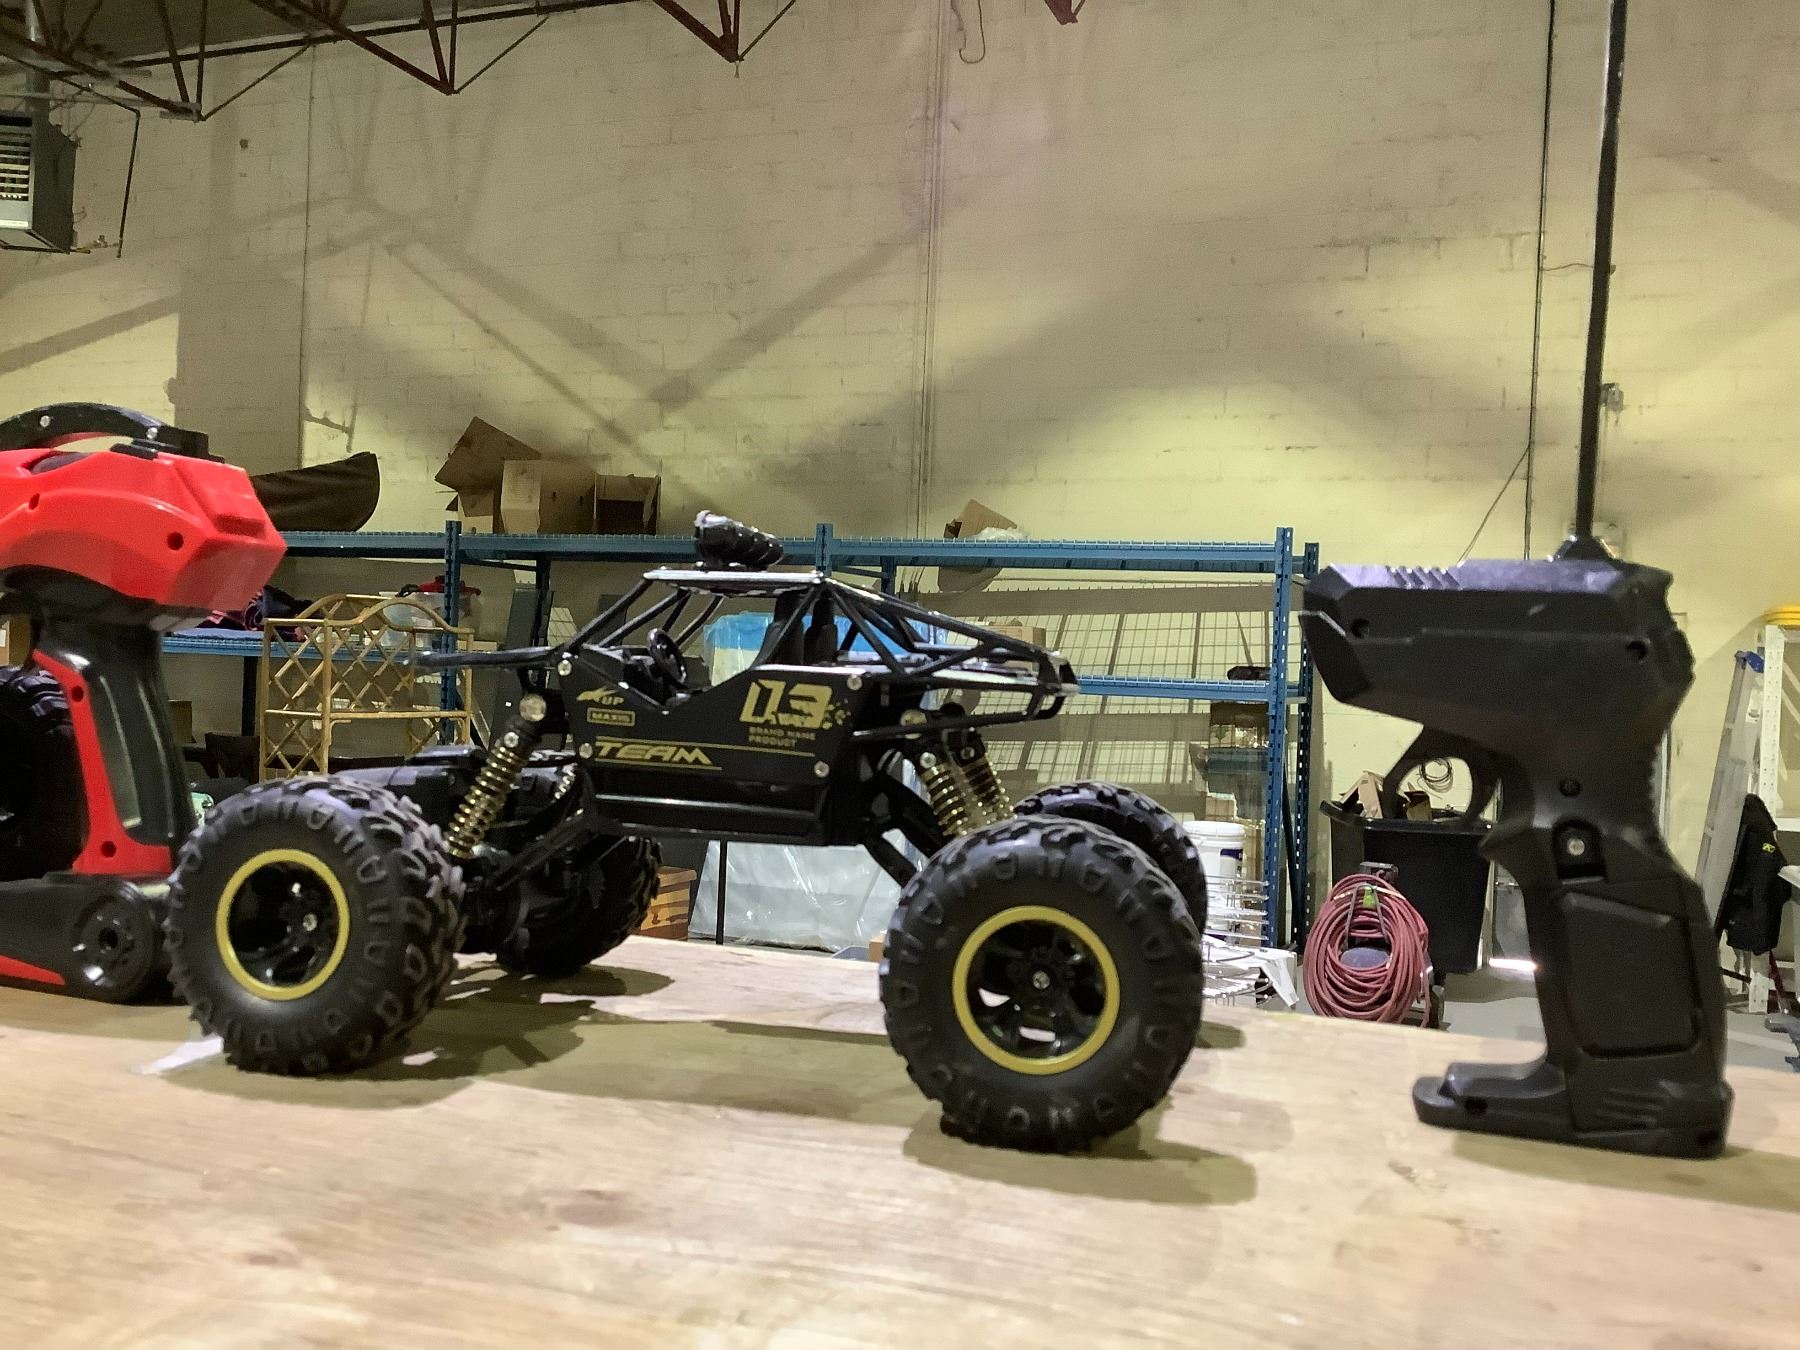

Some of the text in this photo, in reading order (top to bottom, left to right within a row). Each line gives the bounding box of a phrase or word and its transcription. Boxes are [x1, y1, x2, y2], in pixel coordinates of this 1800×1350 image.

[749, 726, 816, 741] BRAND NAME
[748, 735, 798, 748] PRODUCT
[595, 741, 713, 765] TEAM
